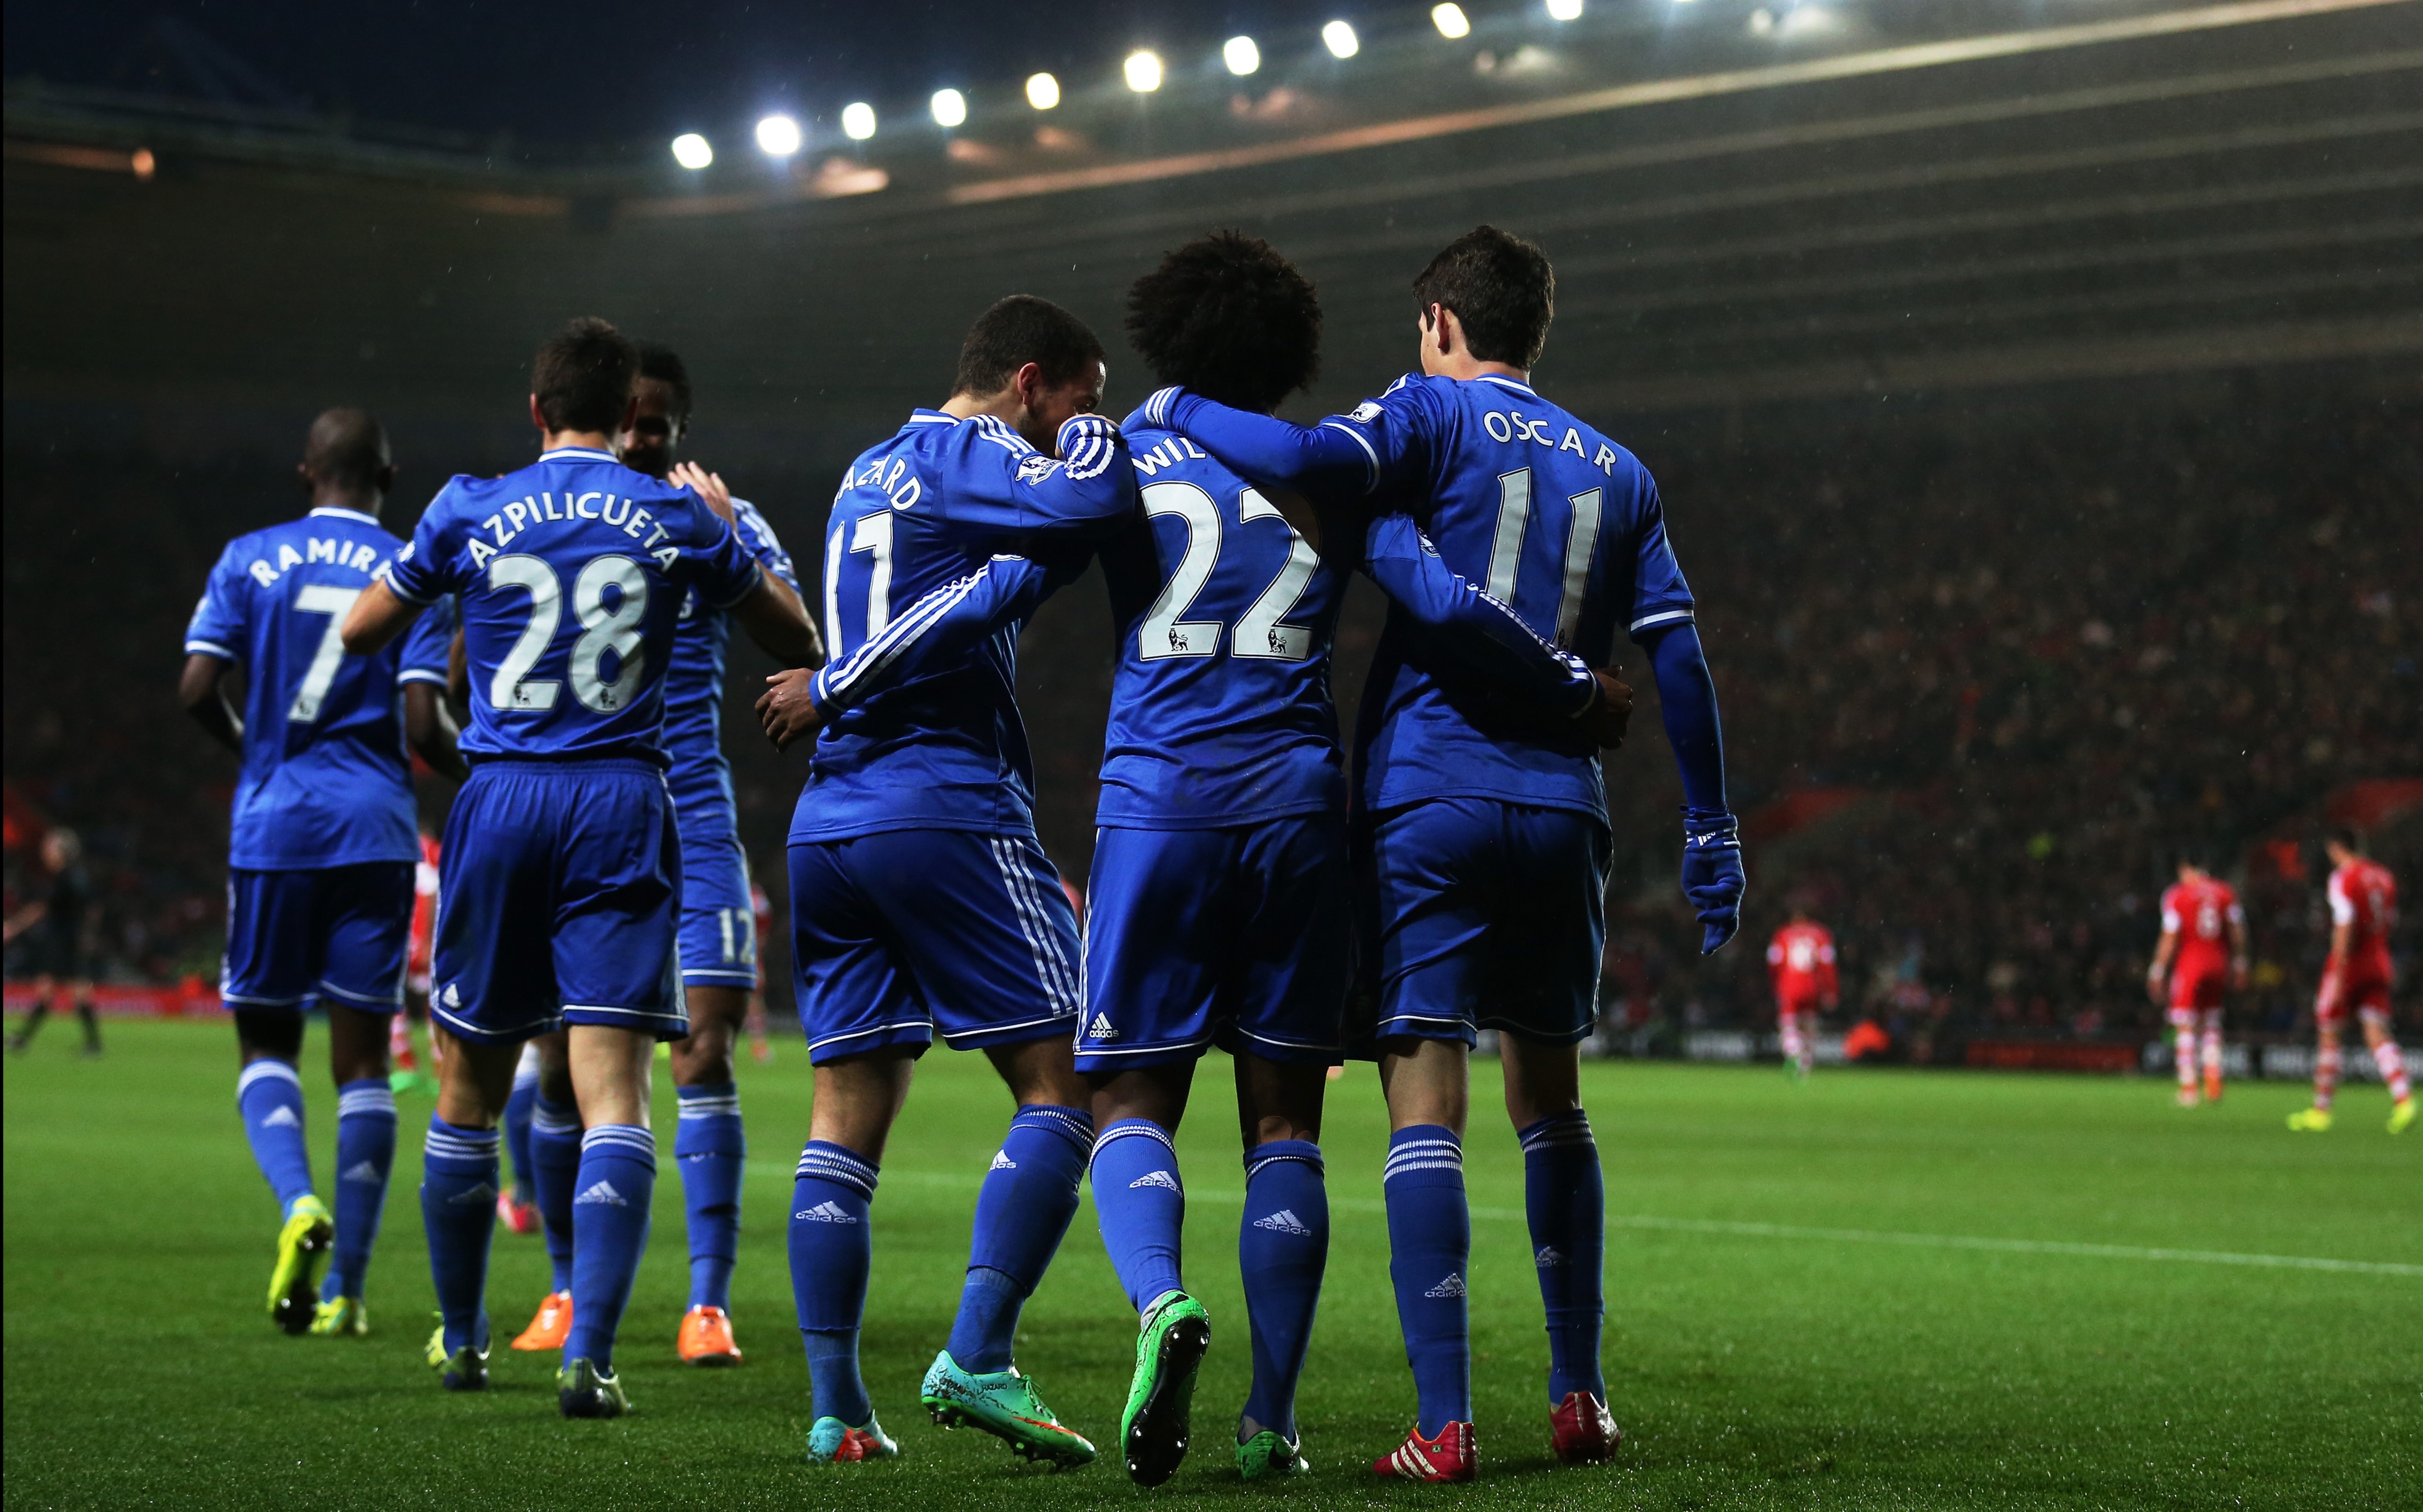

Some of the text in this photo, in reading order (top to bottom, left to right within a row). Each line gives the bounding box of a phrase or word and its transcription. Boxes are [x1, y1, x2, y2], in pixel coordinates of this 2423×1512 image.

[1483, 411, 1617, 477] OSCAR
[468, 492, 680, 572] AZPILICUETA
[1138, 481, 1320, 661] 22
[1484, 467, 1602, 651] 11
[825, 509, 893, 662] 17
[288, 584, 361, 723] 7
[489, 553, 649, 714] 28
[718, 908, 755, 964] 12
[1089, 1028, 1119, 1038] adidas
[796, 1212, 857, 1223] adidas
[1253, 1221, 1311, 1236] adidas
